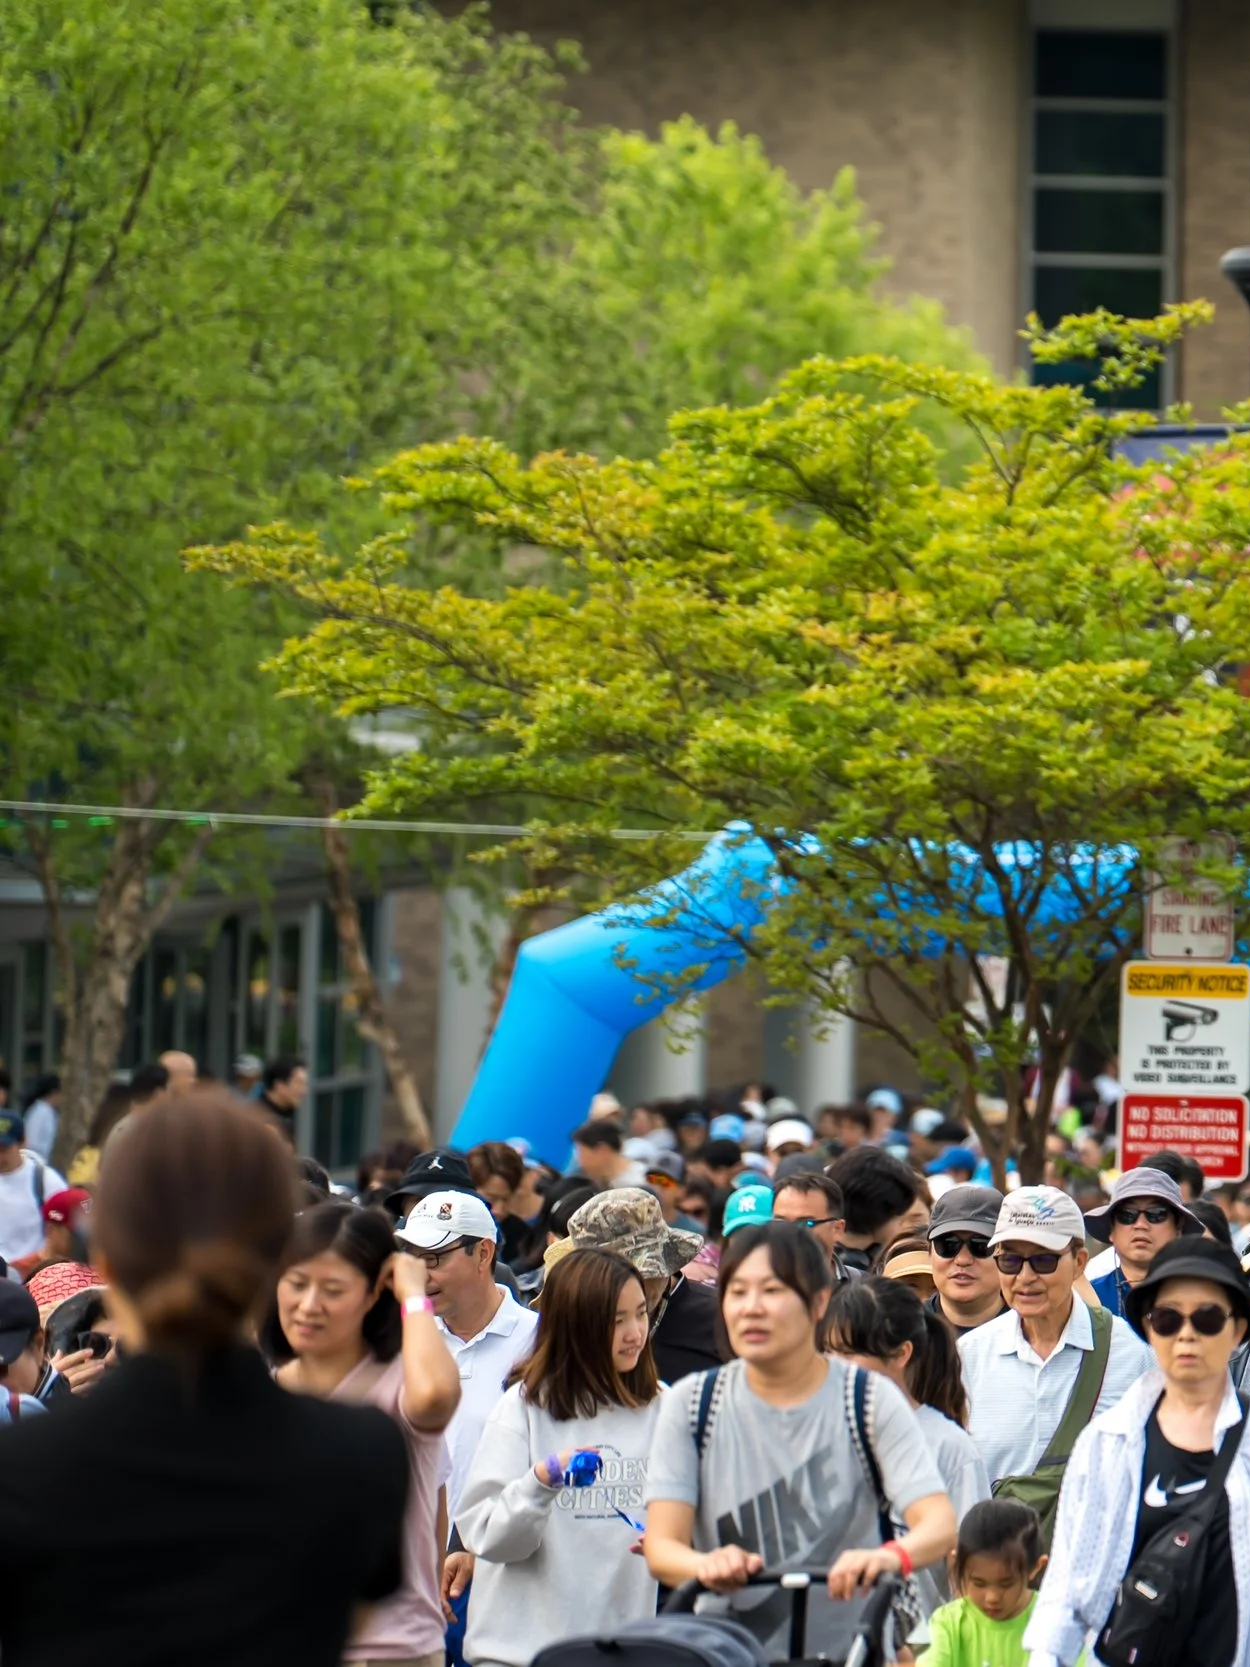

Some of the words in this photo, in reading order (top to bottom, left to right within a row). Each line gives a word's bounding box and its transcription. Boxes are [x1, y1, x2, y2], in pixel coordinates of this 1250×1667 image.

[1149, 914, 1182, 934] FIRE
[1189, 915, 1229, 936] LANE
[1127, 973, 1195, 991] SECURITY
[1198, 975, 1247, 993] NOTICE
[1174, 1046, 1225, 1057] PROPERTY
[1156, 1059, 1212, 1070] PROTECTED
[1217, 1060, 1230, 1070] BY
[1133, 1072, 1161, 1082] VIDEO
[1167, 1073, 1237, 1084] SURVEILLANCE
[1129, 1106, 1150, 1121] NO
[1152, 1106, 1238, 1123] SOLICITATION
[1127, 1124, 1148, 1139] NO
[1150, 1125, 1239, 1142] DISTRIBUTION
[1195, 1144, 1240, 1156] APPROVAL
[555, 1485, 644, 1510] CITIES
[716, 1445, 846, 1568] NIKE
